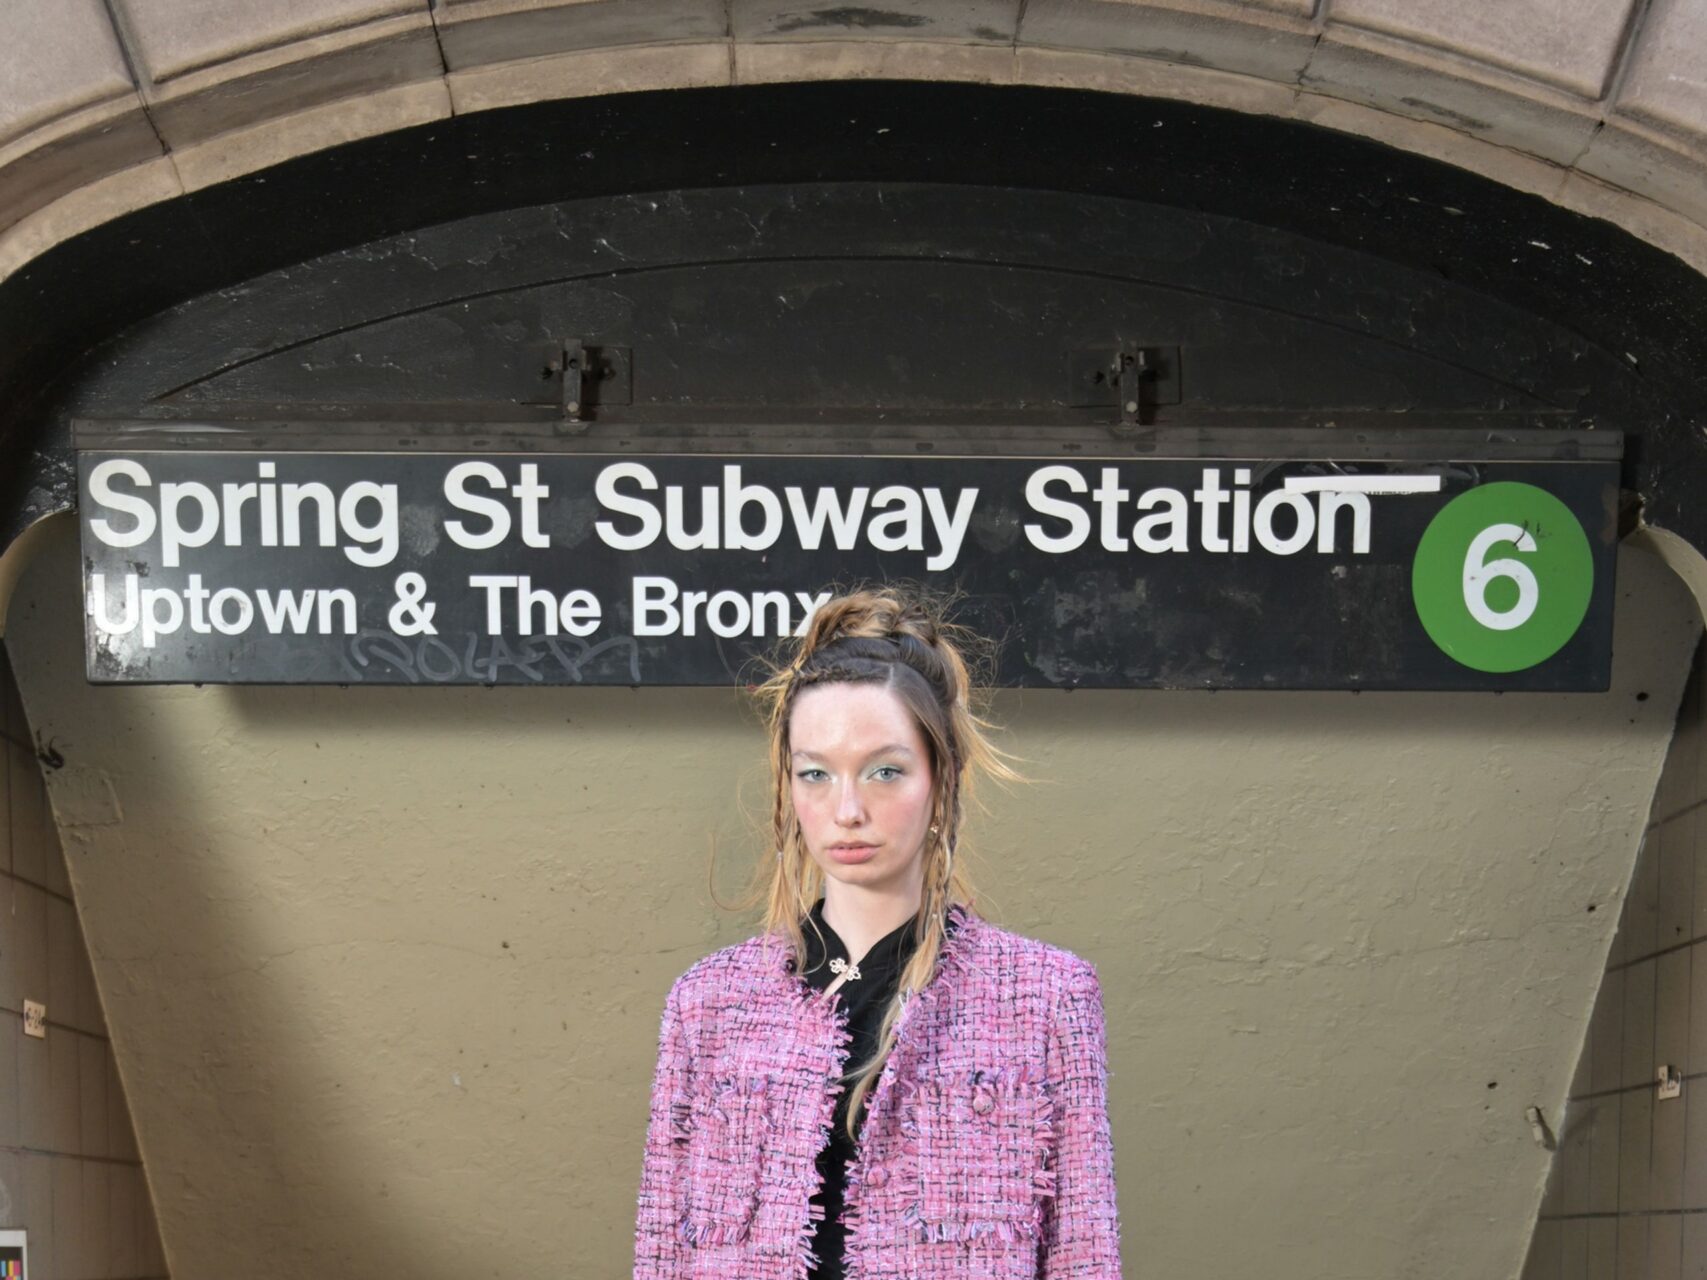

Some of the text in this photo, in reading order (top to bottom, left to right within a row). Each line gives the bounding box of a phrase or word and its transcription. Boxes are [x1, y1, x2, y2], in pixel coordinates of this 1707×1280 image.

[88, 458, 1372, 571] Spring St Subway Station
[91, 571, 833, 649] Uptown & The Bronx
[1462, 522, 1539, 631] 6
